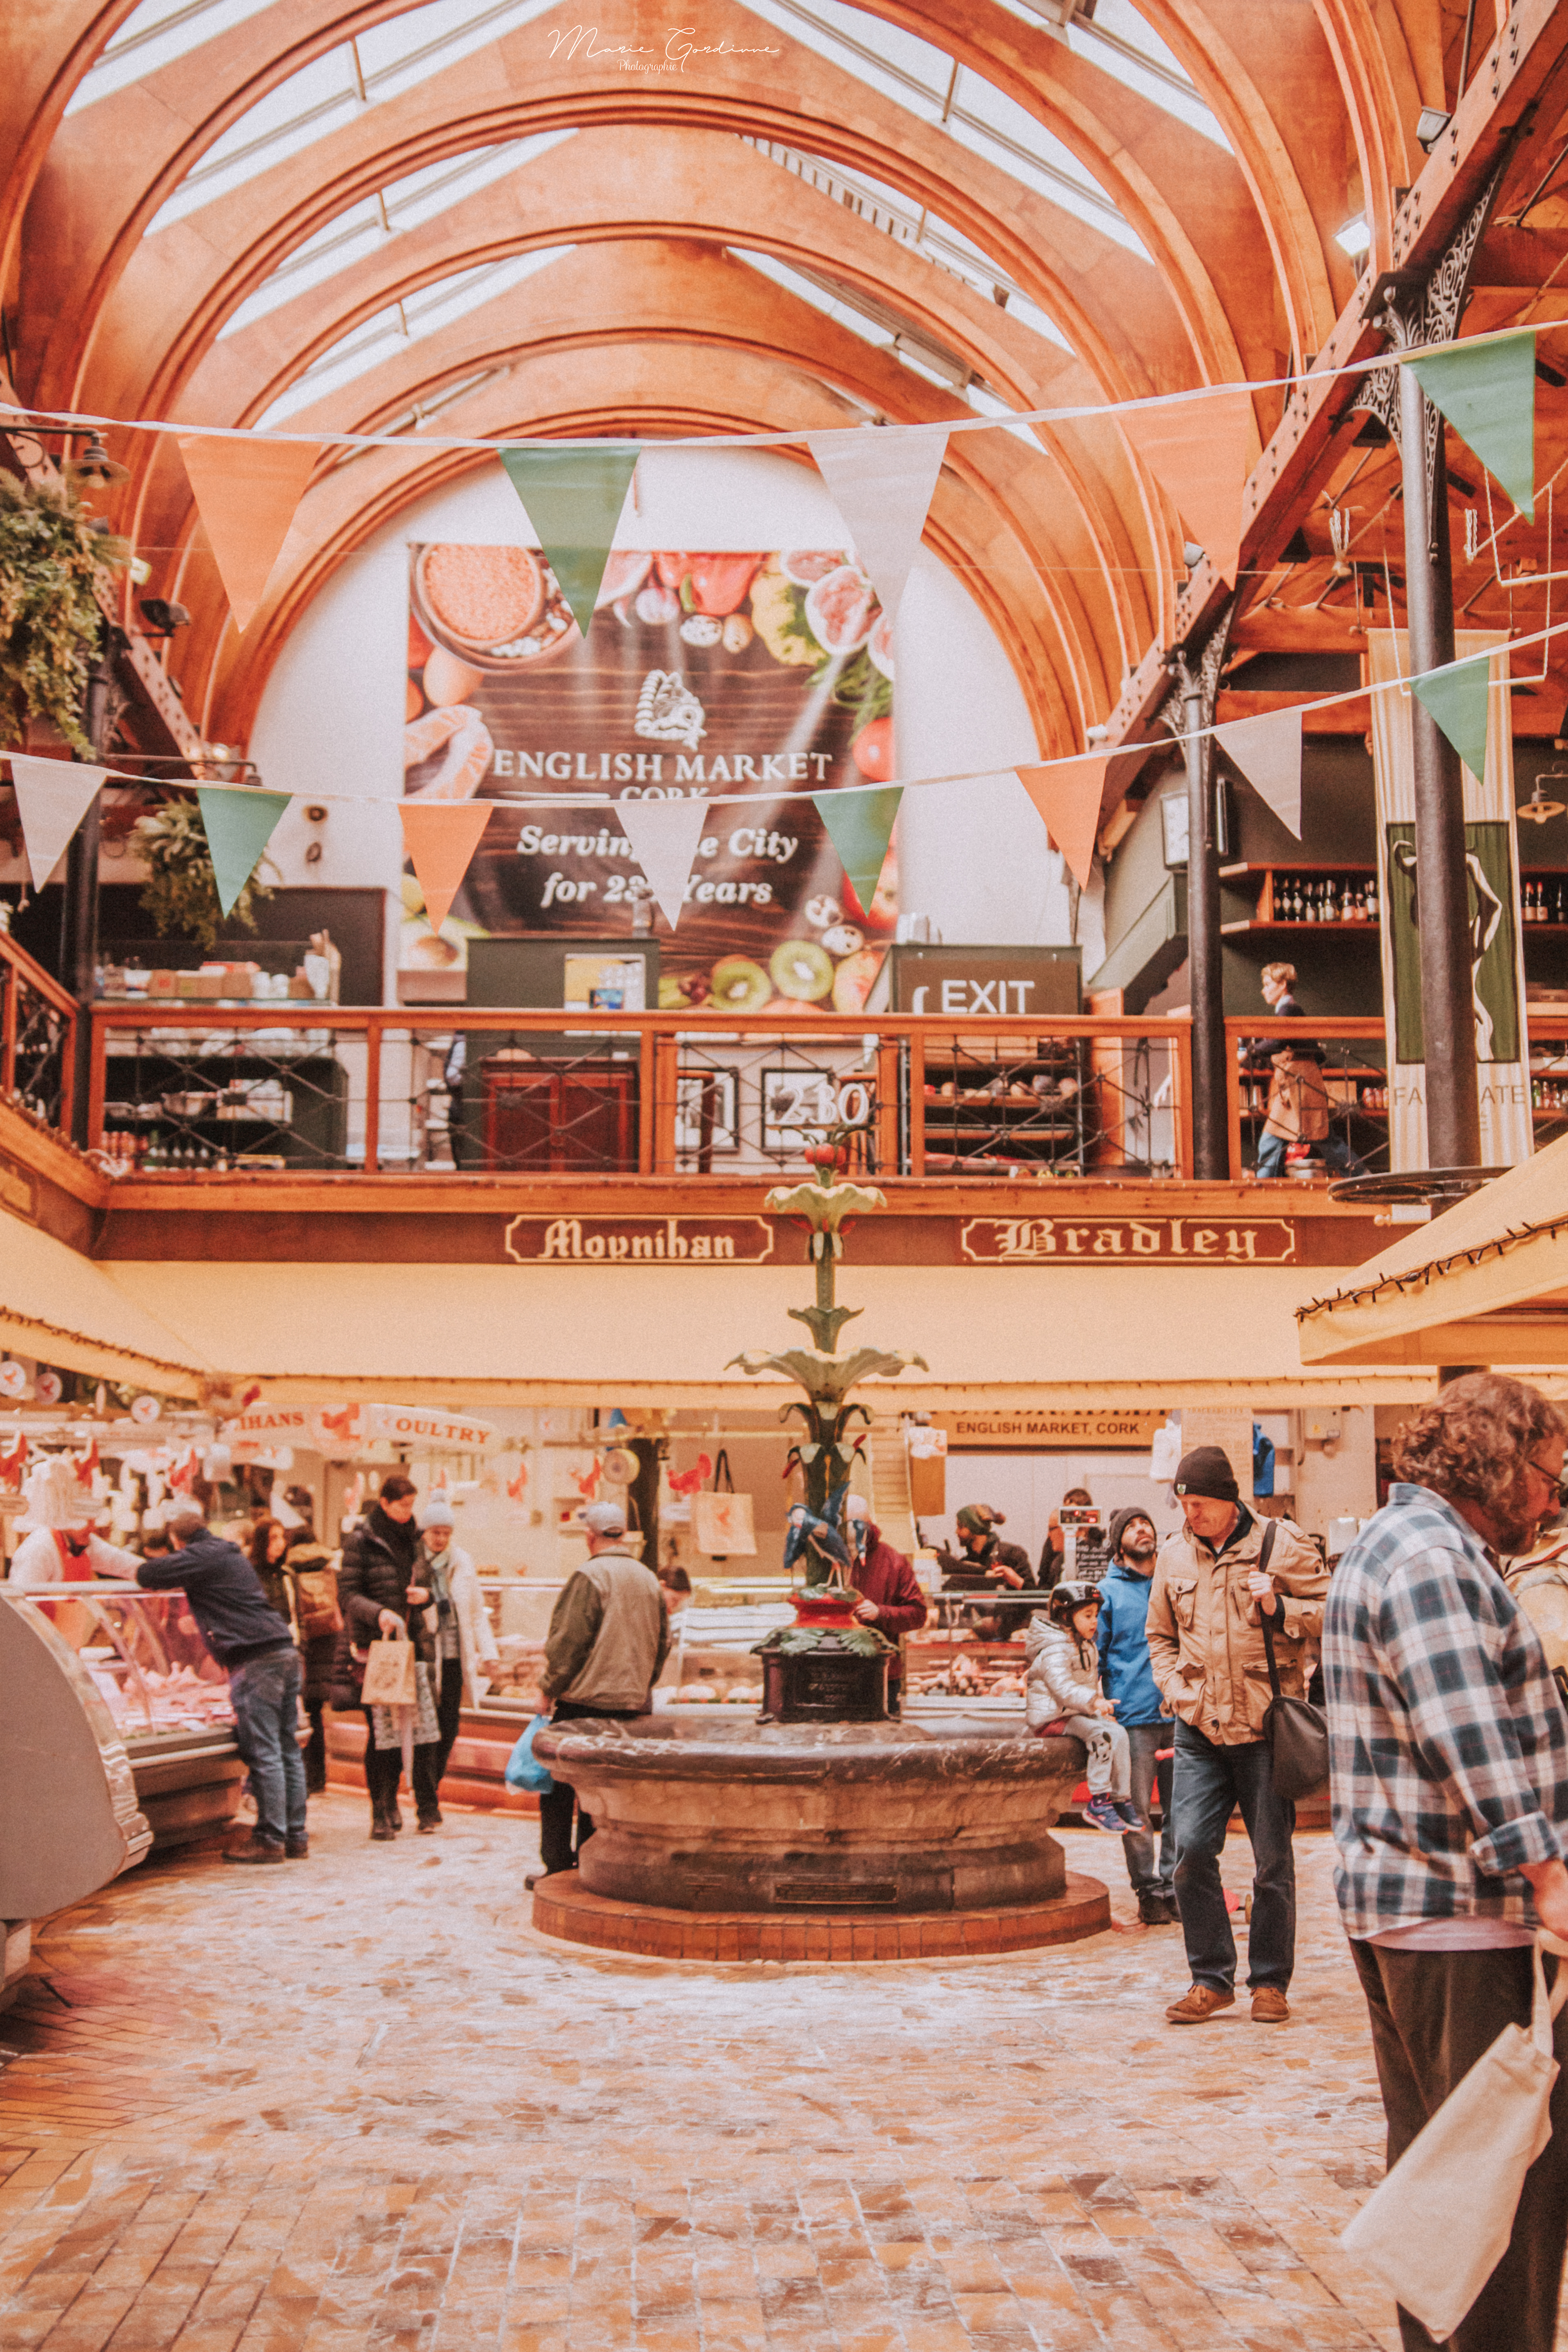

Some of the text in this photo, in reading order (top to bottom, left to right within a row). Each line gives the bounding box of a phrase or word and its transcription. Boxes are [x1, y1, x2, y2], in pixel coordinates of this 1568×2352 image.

[493, 750, 833, 782] ENGLISH MARKET
[517, 824, 640, 863] Servin
[728, 827, 799, 864] City
[539, 871, 598, 909] for
[603, 874, 658, 903] 23
[942, 979, 1036, 1014] EXIT
[537, 1219, 735, 1261] Moynihan
[994, 1218, 1258, 1263] Bradley
[395, 1417, 491, 1445] OULTRY
[956, 1421, 1140, 1436] ENGLISH MARKET, CORK
